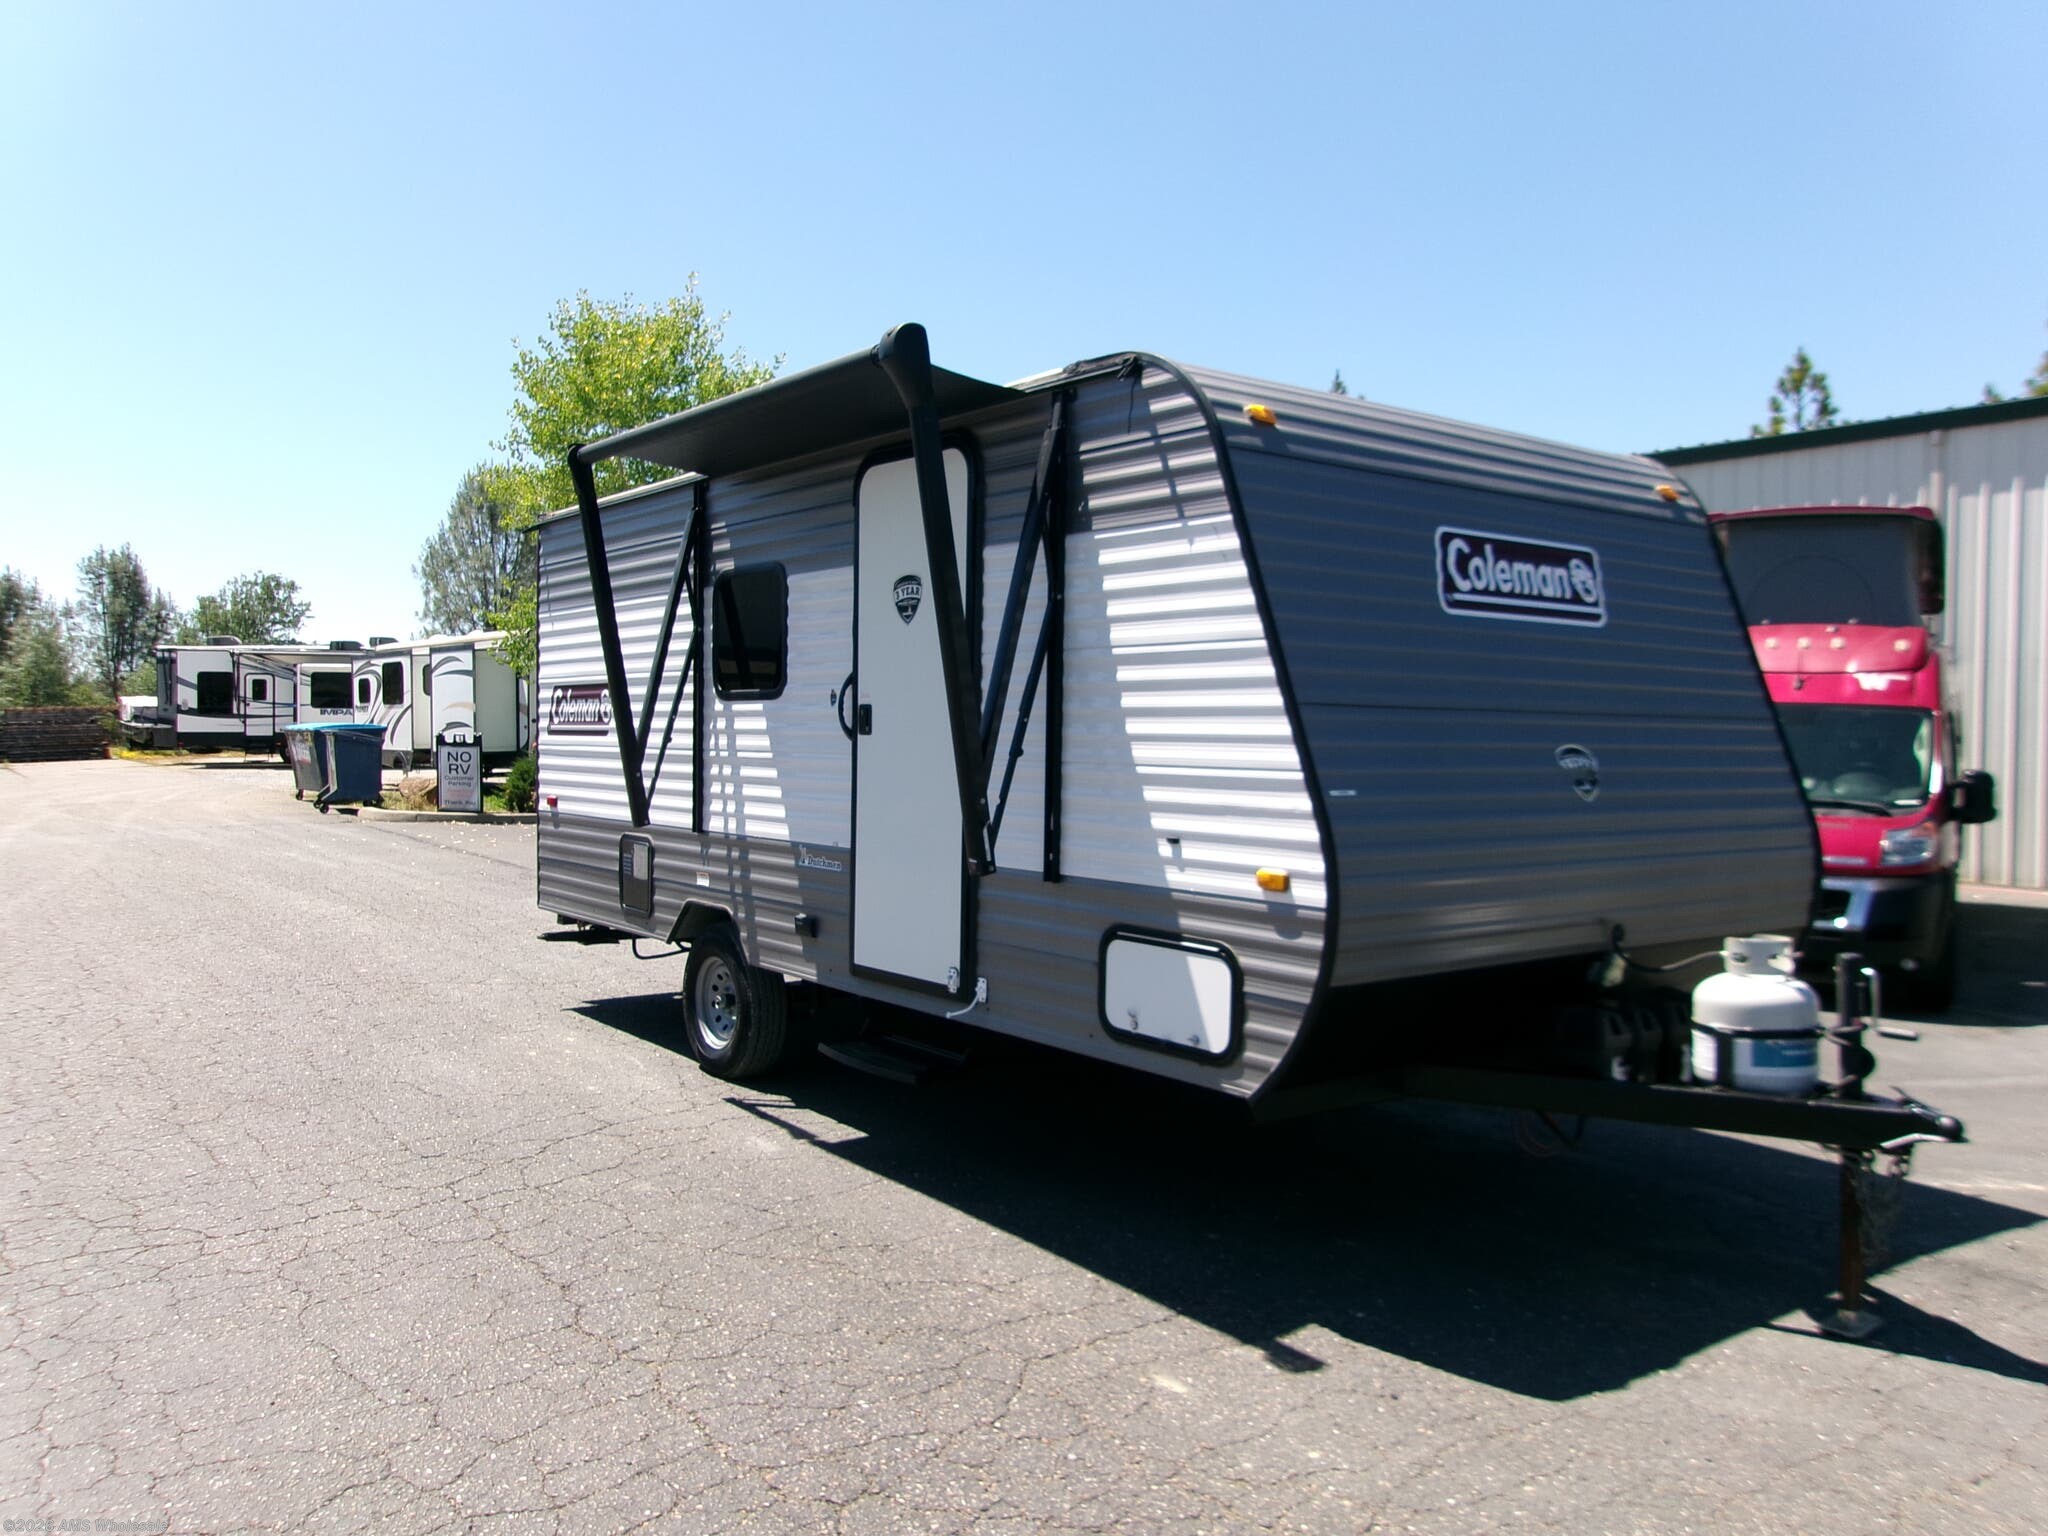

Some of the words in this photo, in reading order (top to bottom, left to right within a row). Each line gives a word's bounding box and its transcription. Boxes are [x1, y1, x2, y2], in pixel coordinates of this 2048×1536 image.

[1446, 537, 1573, 600] Coleman
[900, 586, 921, 597] YEAR
[551, 687, 599, 725] Coleman
[447, 751, 472, 763] NO
[448, 763, 471, 775] RV
[807, 854, 842, 872] Dutchmen
